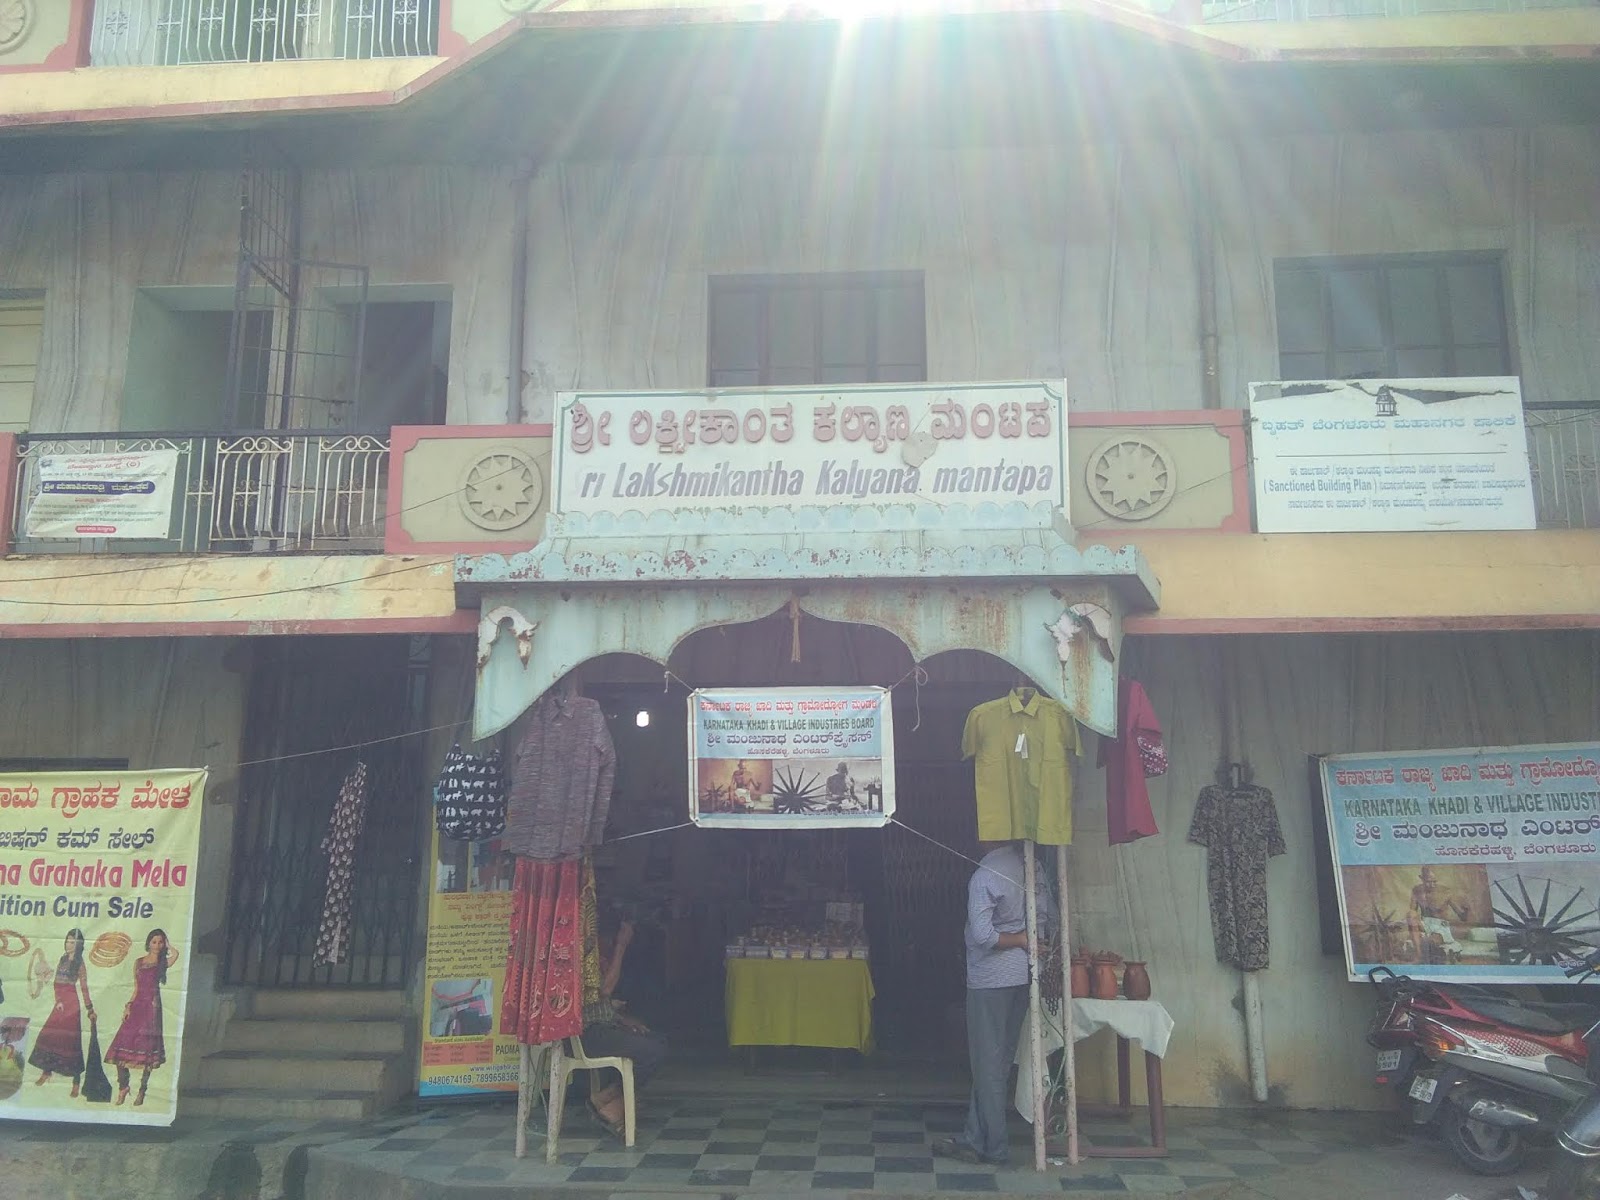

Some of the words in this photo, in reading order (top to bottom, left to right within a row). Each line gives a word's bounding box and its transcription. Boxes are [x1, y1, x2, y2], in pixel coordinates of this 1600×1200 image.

[571, 403, 611, 453] ಶ್ರೀ
[813, 402, 910, 453] ಕಲ್ಯಾಣ
[931, 398, 1050, 439] ಮಂಟಪ
[1262, 419, 1304, 435] ಬೃಹತ್
[1312, 418, 1386, 430] ಬೆಂಗಳೂರು
[1393, 417, 1465, 429] ಮಹಾನಗರ
[1474, 414, 1516, 427] ಪಾಲಿಕೆ
[816, 459, 921, 499] Kalyana
[933, 458, 1053, 495] mantapa
[1318, 478, 1351, 493] Building
[700, 701, 731, 711] ಕರ್ನಾಟಕ
[735, 702, 753, 717] ರಾಜ್ಯ
[776, 700, 793, 715] ಮತ್ತು
[703, 718, 744, 731] KARNATAKA
[747, 719, 769, 730] KHADI
[770, 719, 775, 730] &
[777, 718, 806, 730] VILLAGE
[809, 718, 849, 730] INDUSTRIES
[851, 717, 875, 729] BOARD
[707, 732, 721, 747] ಶ್ರೀ
[727, 733, 786, 745] ಮಂಜುನಾಥ
[1336, 766, 1394, 786] ಕರ್ನಾಟಕ
[1401, 767, 1437, 792] ರಾಜ್ಯ
[1441, 764, 1472, 782] ಖಾದಿ
[1479, 761, 1515, 786] ಮತ್ತು
[51, 780, 121, 818] ಗ್ರಾಹಕ
[131, 779, 191, 809] ಮೇಳ
[1344, 798, 1422, 818] KARNATAKA
[1428, 796, 1469, 816] KHADI
[1474, 796, 1483, 814] &
[1486, 793, 1544, 814] VILLAGE
[57, 827, 100, 849] ಕಮ್
[107, 827, 154, 849] ಸೇಲ್
[1355, 822, 1381, 847] ಶ್ರೀ
[1392, 818, 1508, 840] ಮಂಜುನಾಥ
[1524, 843, 1596, 855] ಬೆಂಗಳೂರು
[29, 858, 123, 888] Grahaka
[131, 859, 187, 888] Mela
[53, 895, 99, 918] Cum
[107, 896, 153, 918] Sale
